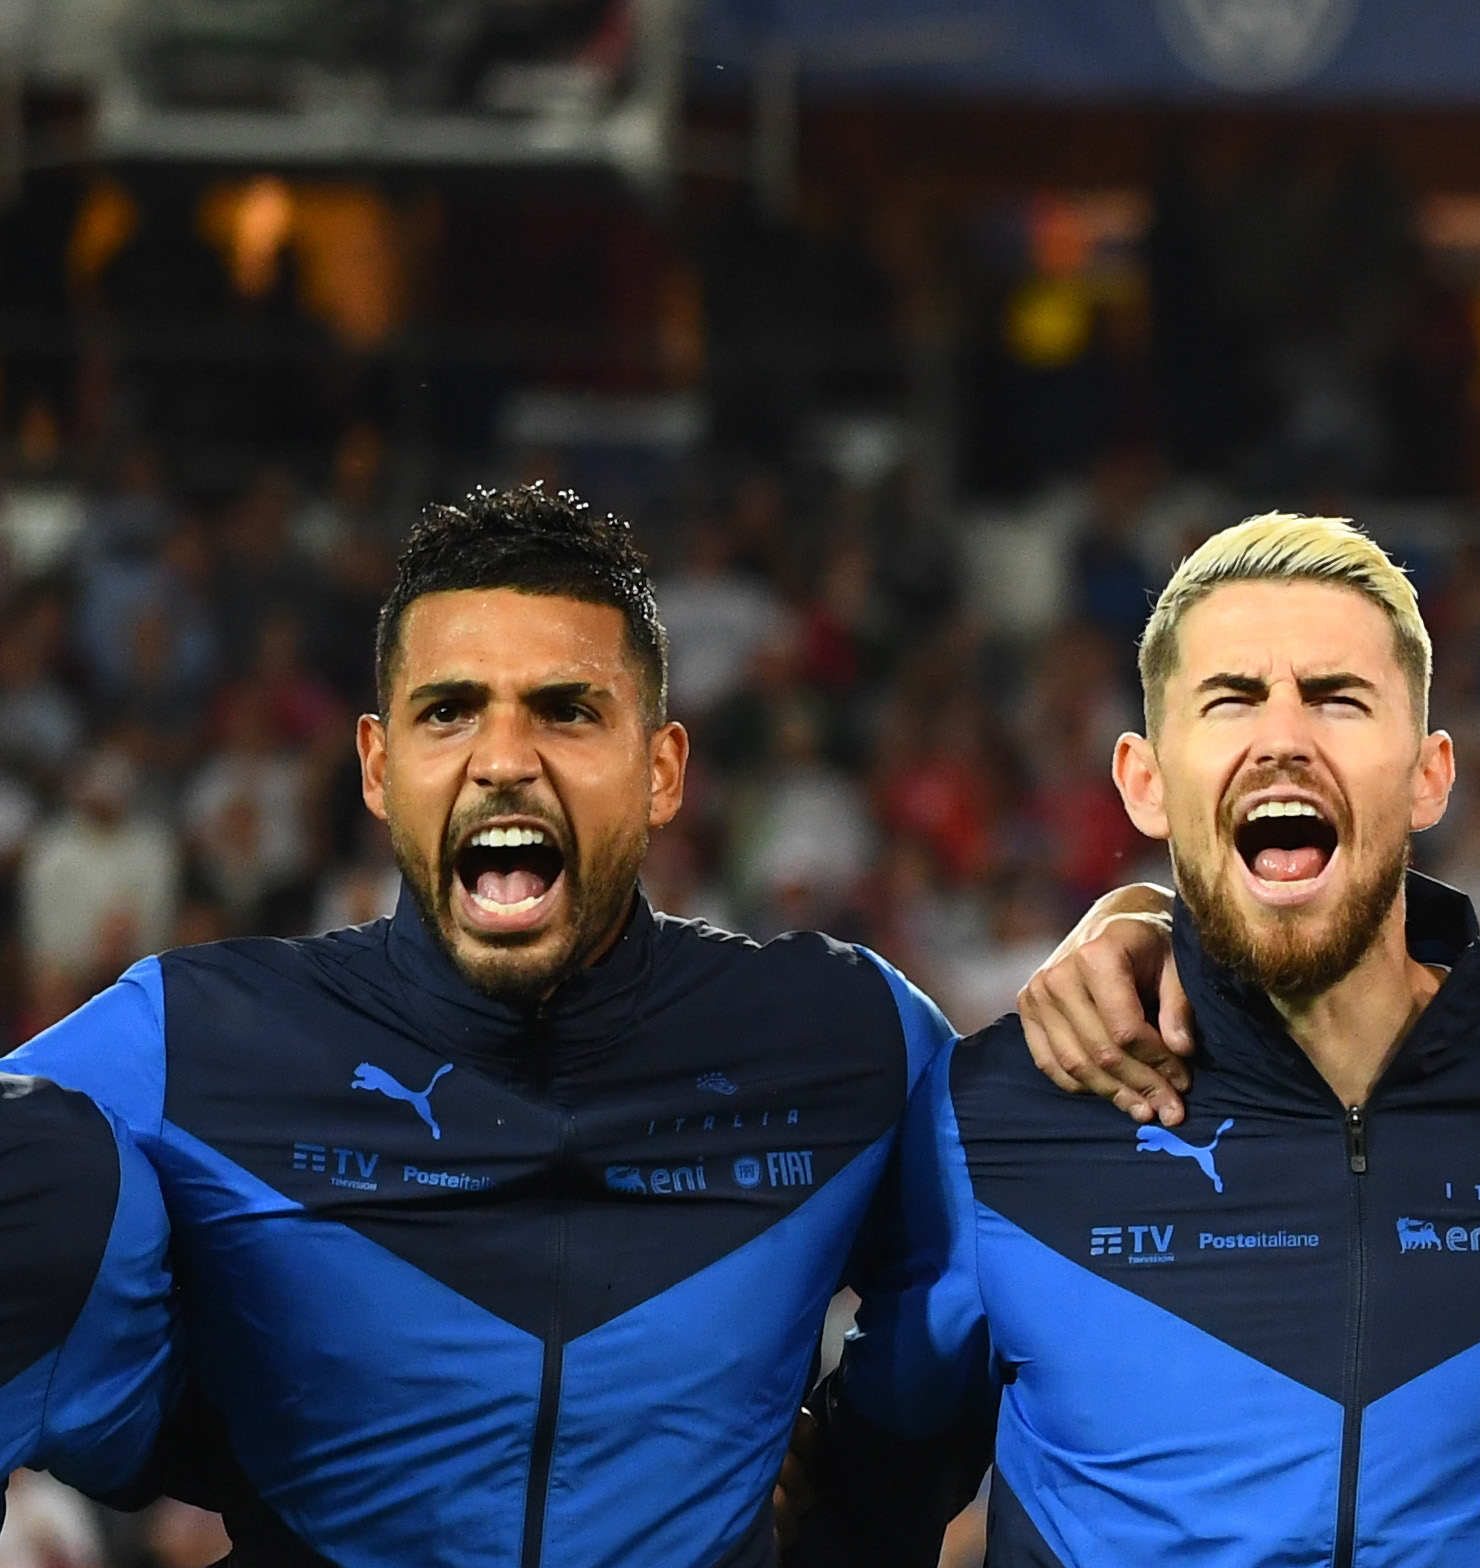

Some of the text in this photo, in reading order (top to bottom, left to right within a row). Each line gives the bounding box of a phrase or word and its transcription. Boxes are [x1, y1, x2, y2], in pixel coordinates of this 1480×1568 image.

[648, 1108, 800, 1136] ITALIA
[333, 1147, 380, 1179] TV
[649, 1156, 708, 1195] eni
[766, 1150, 814, 1188] FIAT
[402, 1165, 496, 1192] Posteitali
[1127, 1224, 1176, 1254] TV
[1199, 1231, 1320, 1250] Posteitaliane
